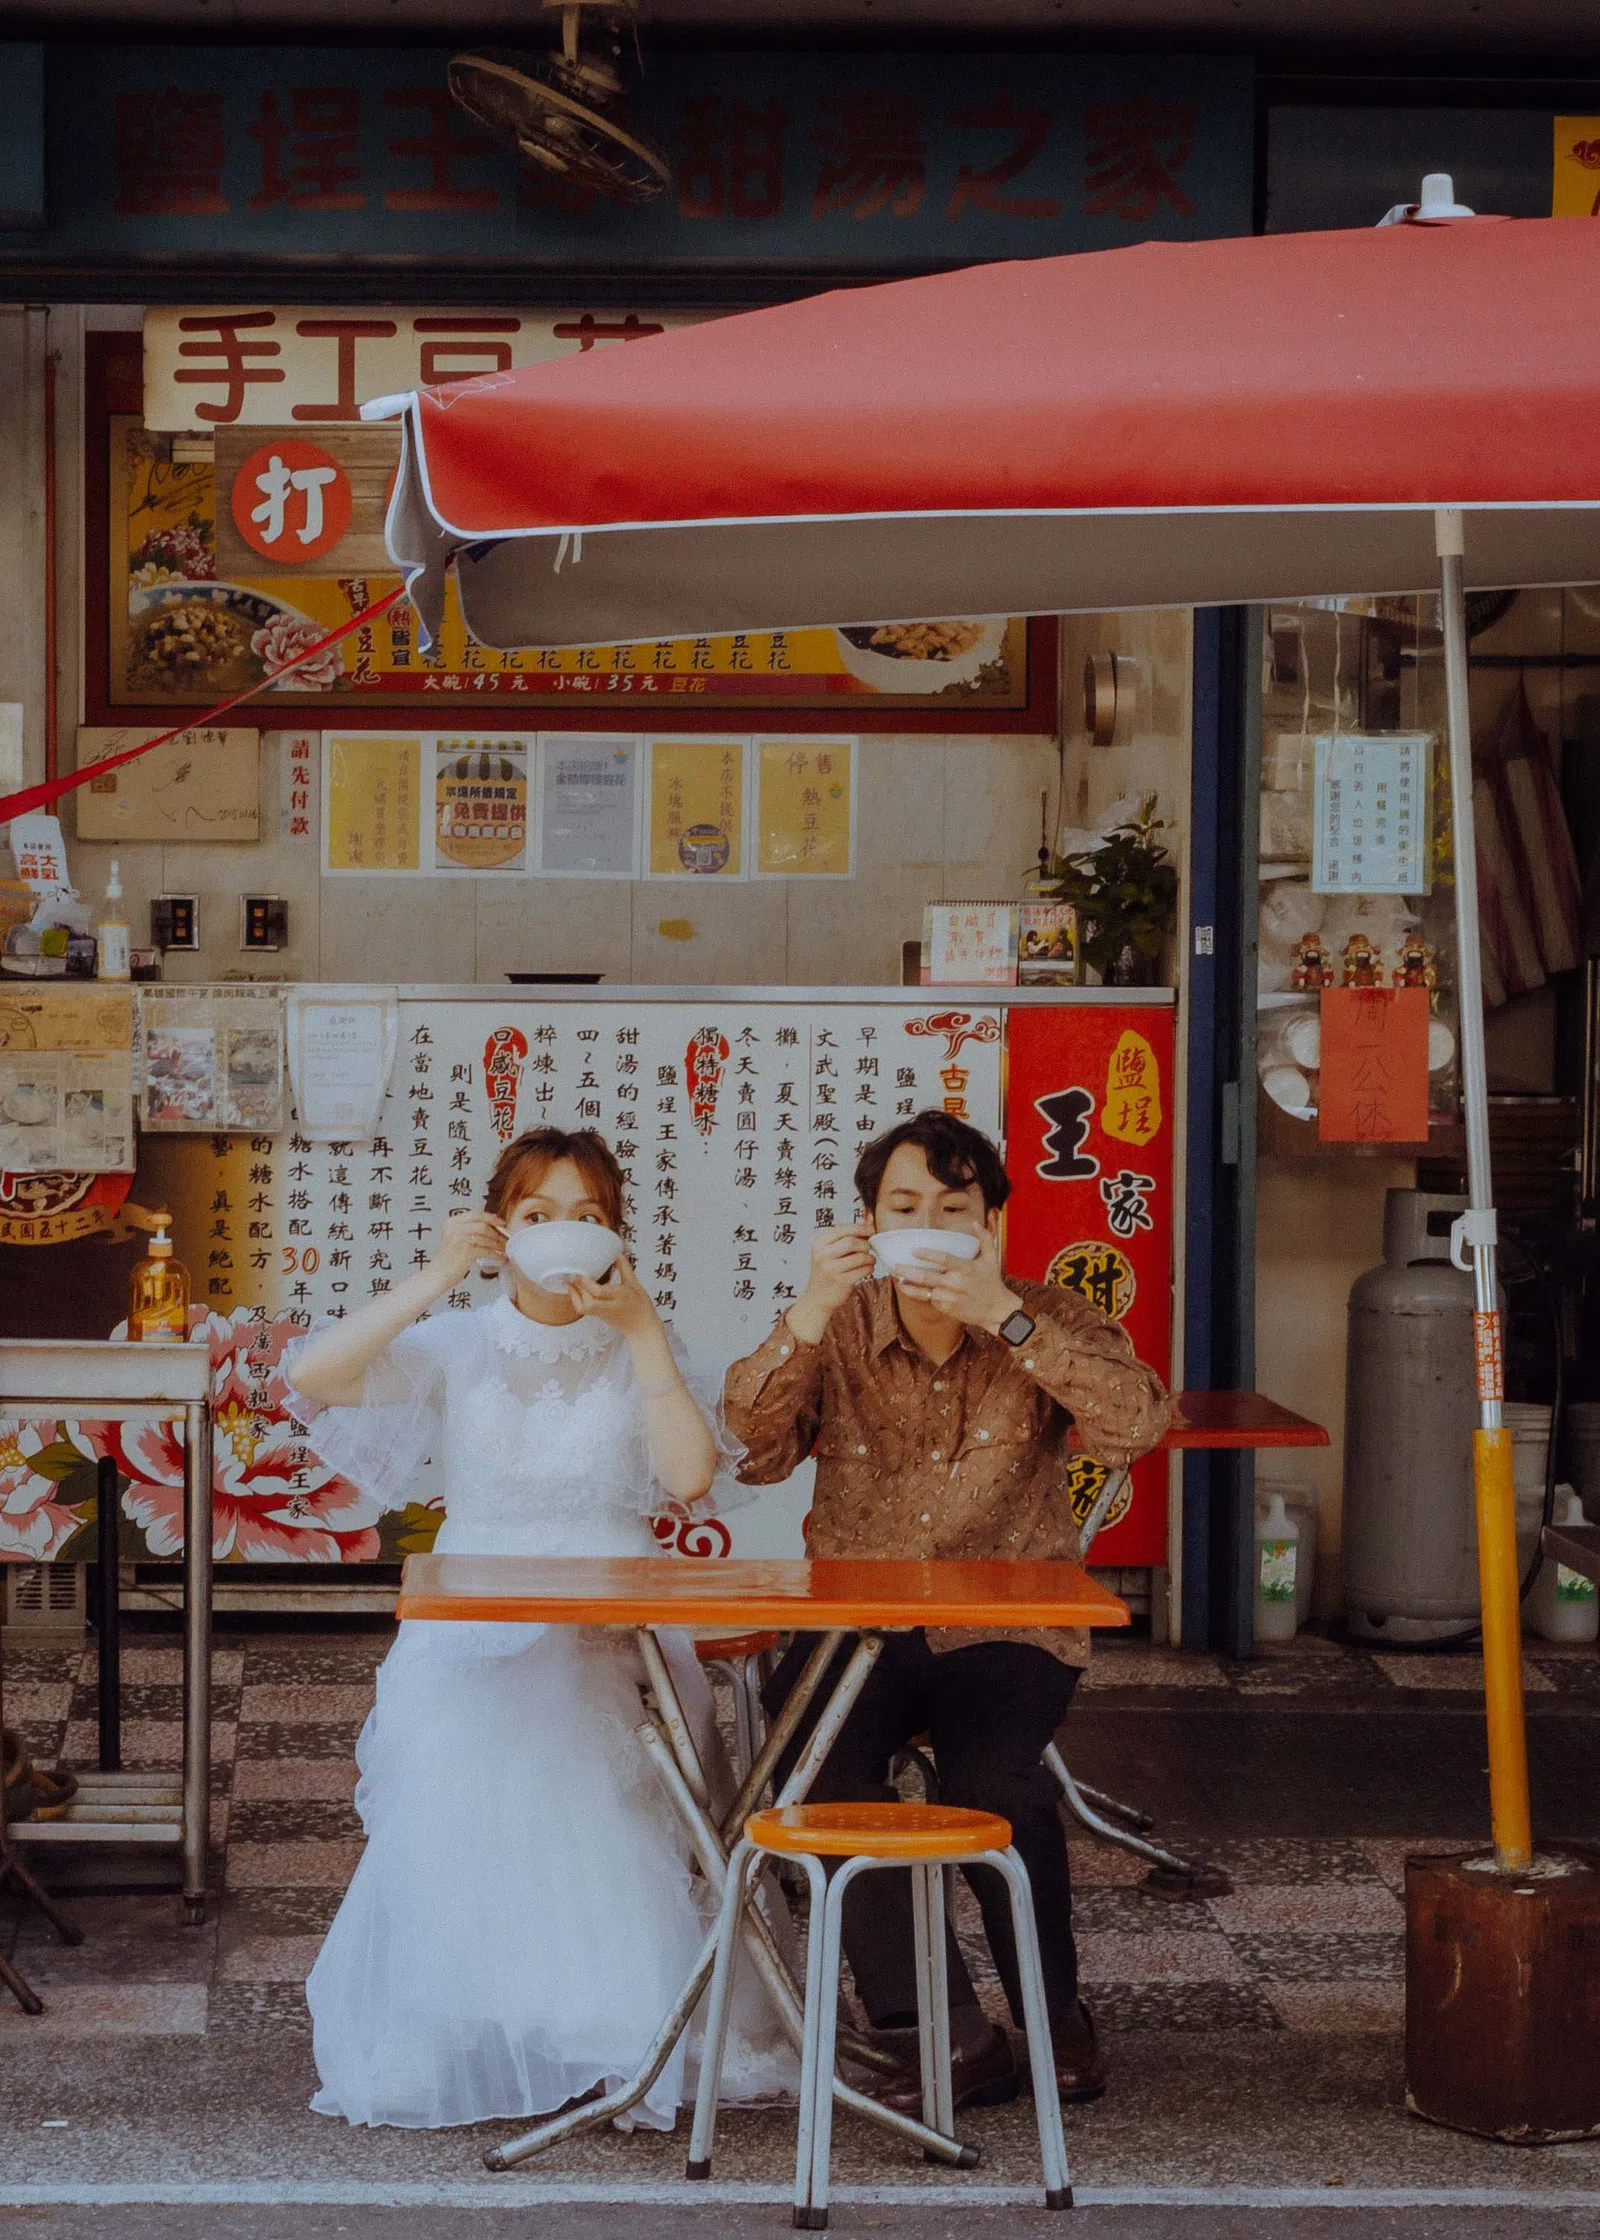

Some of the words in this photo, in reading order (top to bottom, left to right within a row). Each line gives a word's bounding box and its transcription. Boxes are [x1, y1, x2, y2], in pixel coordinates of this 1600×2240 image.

[173, 311, 665, 423] 手工豆
[250, 454, 337, 544] 打
[290, 740, 309, 836] 請先付款
[718, 751, 735, 833] 本店不提供
[785, 751, 833, 775] 停售
[800, 787, 821, 857] 熱豆花
[1113, 1045, 1152, 1134] 鹽埕
[1348, 990, 1393, 1138] 周一公休
[409, 1025, 434, 1270] 在當地賣豆花三十年
